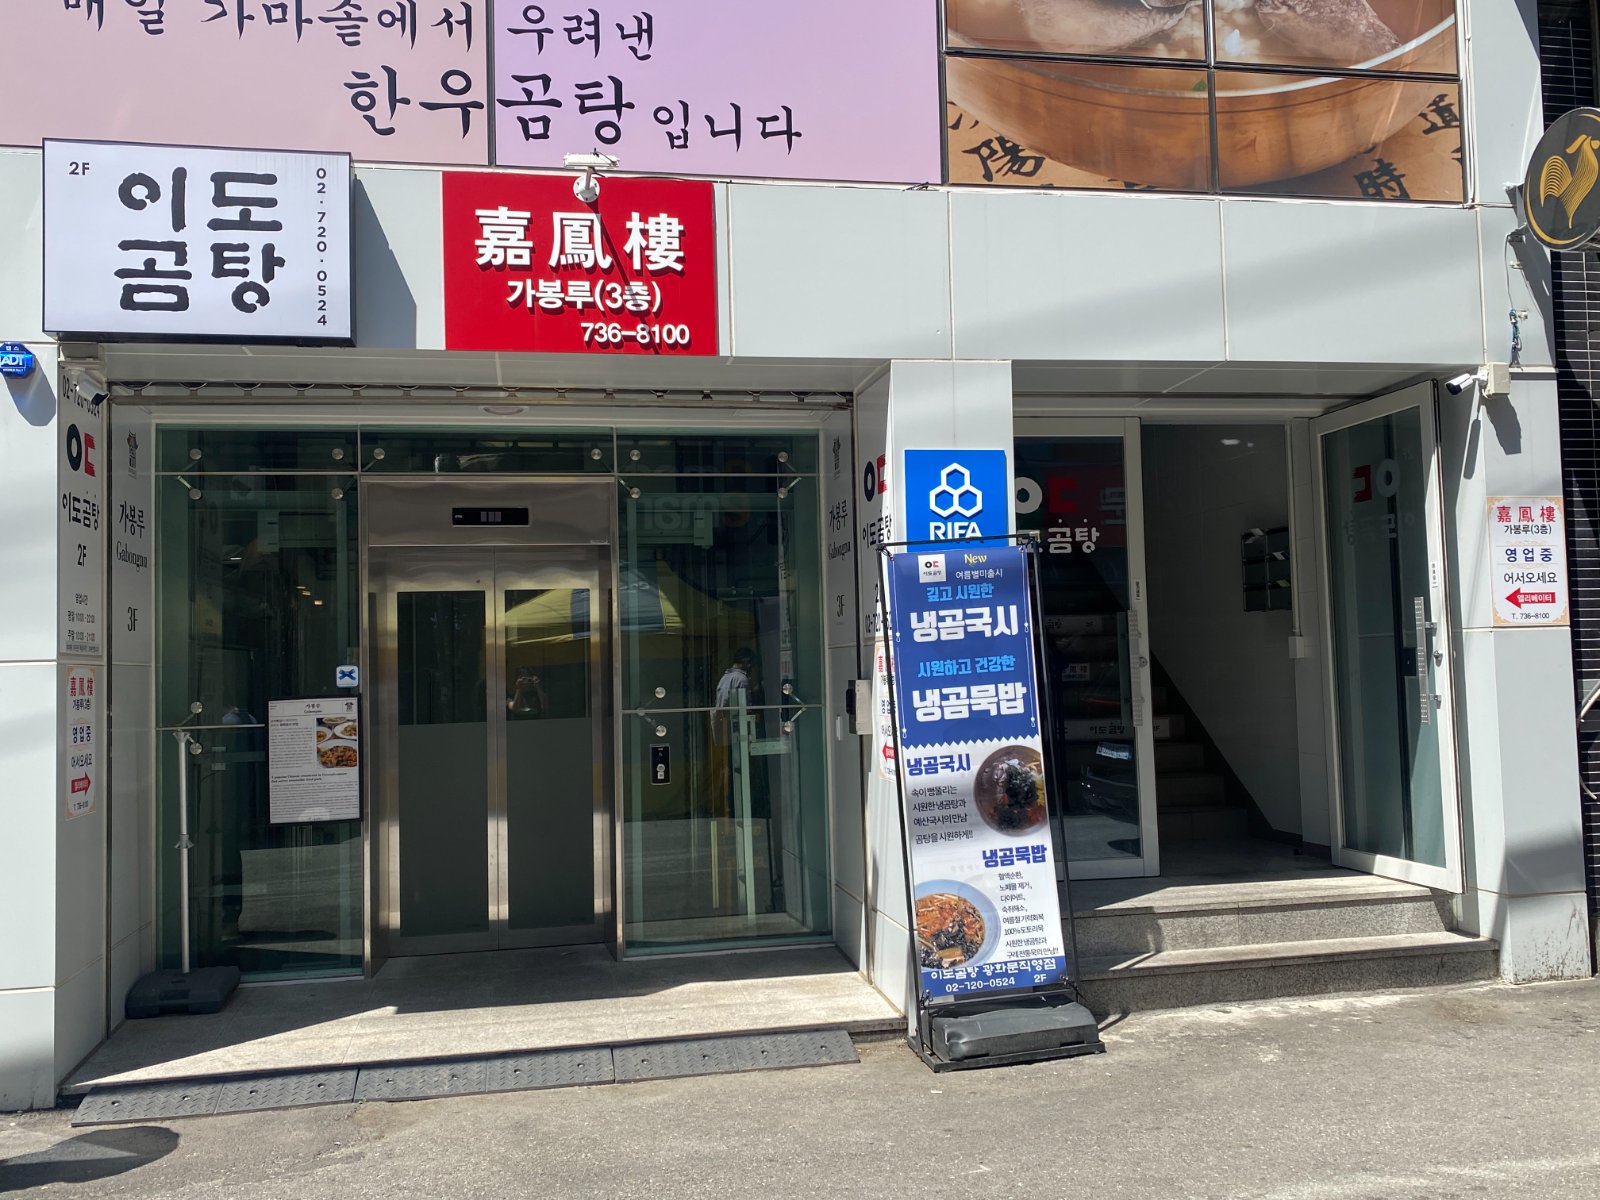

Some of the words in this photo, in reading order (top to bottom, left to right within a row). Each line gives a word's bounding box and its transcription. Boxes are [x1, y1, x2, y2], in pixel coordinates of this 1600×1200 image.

[507, 5, 655, 61] 우려낸
[69, 162, 90, 176] 2F
[475, 206, 685, 271] 嘉鳳樓
[507, 279, 661, 311] 가봉루(3층)
[581, 322, 689, 345] 736-8100
[1, 353, 23, 366] ADT
[62, 491, 100, 531] 이도곰탕
[119, 501, 146, 539] 가봉루
[829, 500, 848, 532] 가봉루
[1497, 506, 1556, 523] 嘉鳳樓
[863, 507, 892, 548] 이도곰탕
[929, 521, 984, 543] RIFA
[1017, 519, 1100, 554] 곰탕
[1504, 524, 1552, 535] 가봉루(3층)
[78, 543, 87, 566] 2F
[964, 553, 987, 566] New
[1504, 572, 1557, 584] 어서오세요
[927, 586, 953, 602] 깊고
[956, 583, 994, 601] 시원한
[127, 607, 138, 631] 3F
[910, 605, 1019, 642] 냉곰국시
[918, 659, 972, 678] 시원하고
[975, 655, 1016, 673] 건강한
[912, 682, 1027, 722] 냉곰묵밥
[906, 753, 971, 777] 냉곰국시
[982, 844, 1047, 868] 냉곰묵밥
[931, 965, 979, 980] 이도곰탕
[946, 976, 1016, 992] 02-720-0524
[1034, 973, 1047, 983] 2F
